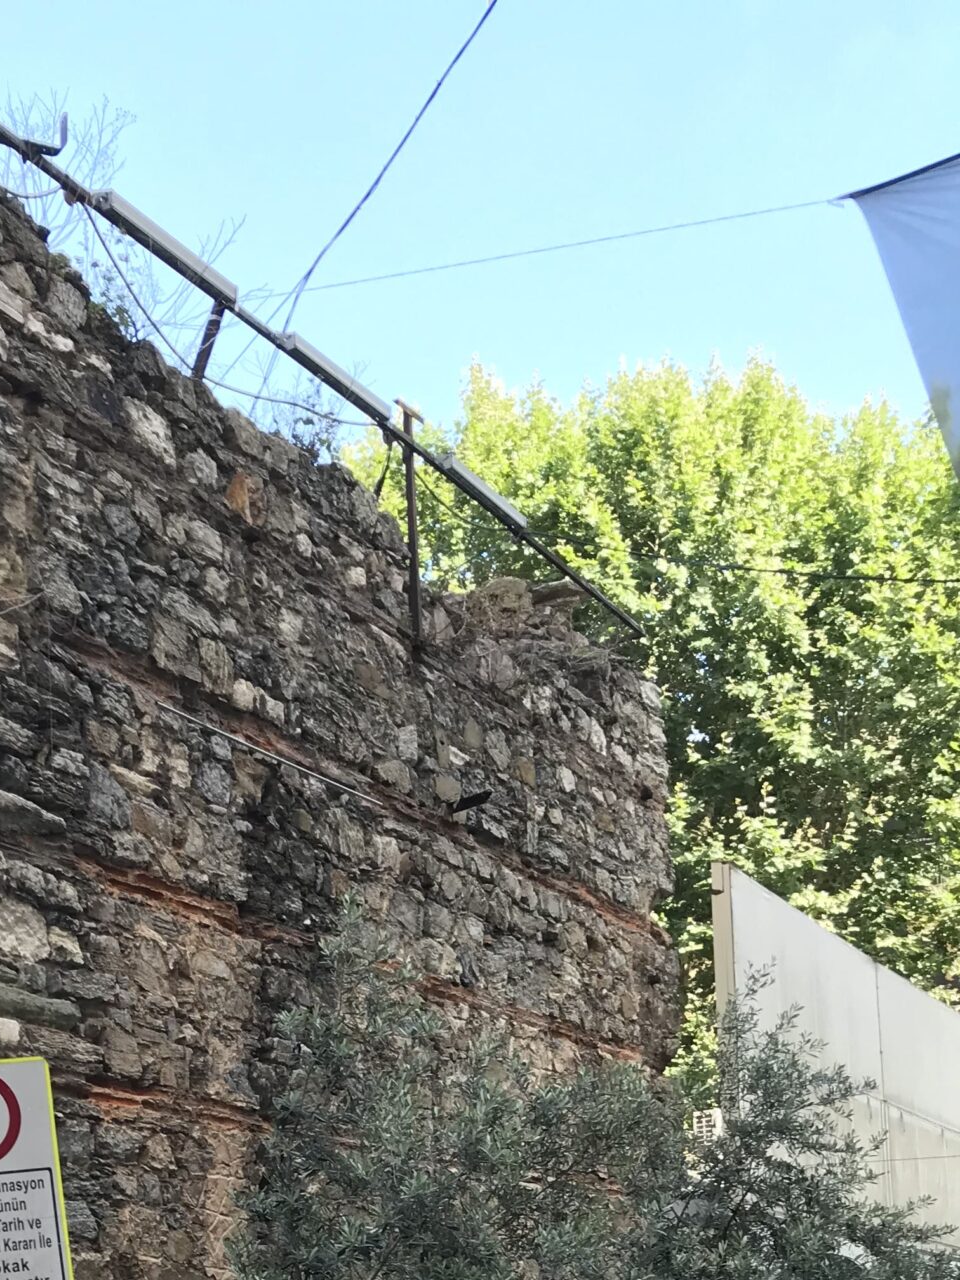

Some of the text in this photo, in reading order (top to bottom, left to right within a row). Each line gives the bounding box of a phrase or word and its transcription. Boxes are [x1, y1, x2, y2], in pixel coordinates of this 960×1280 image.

[27, 1218, 42, 1231] ve
[3, 1238, 37, 1251] Kararı
[39, 1232, 52, 1248] İle
